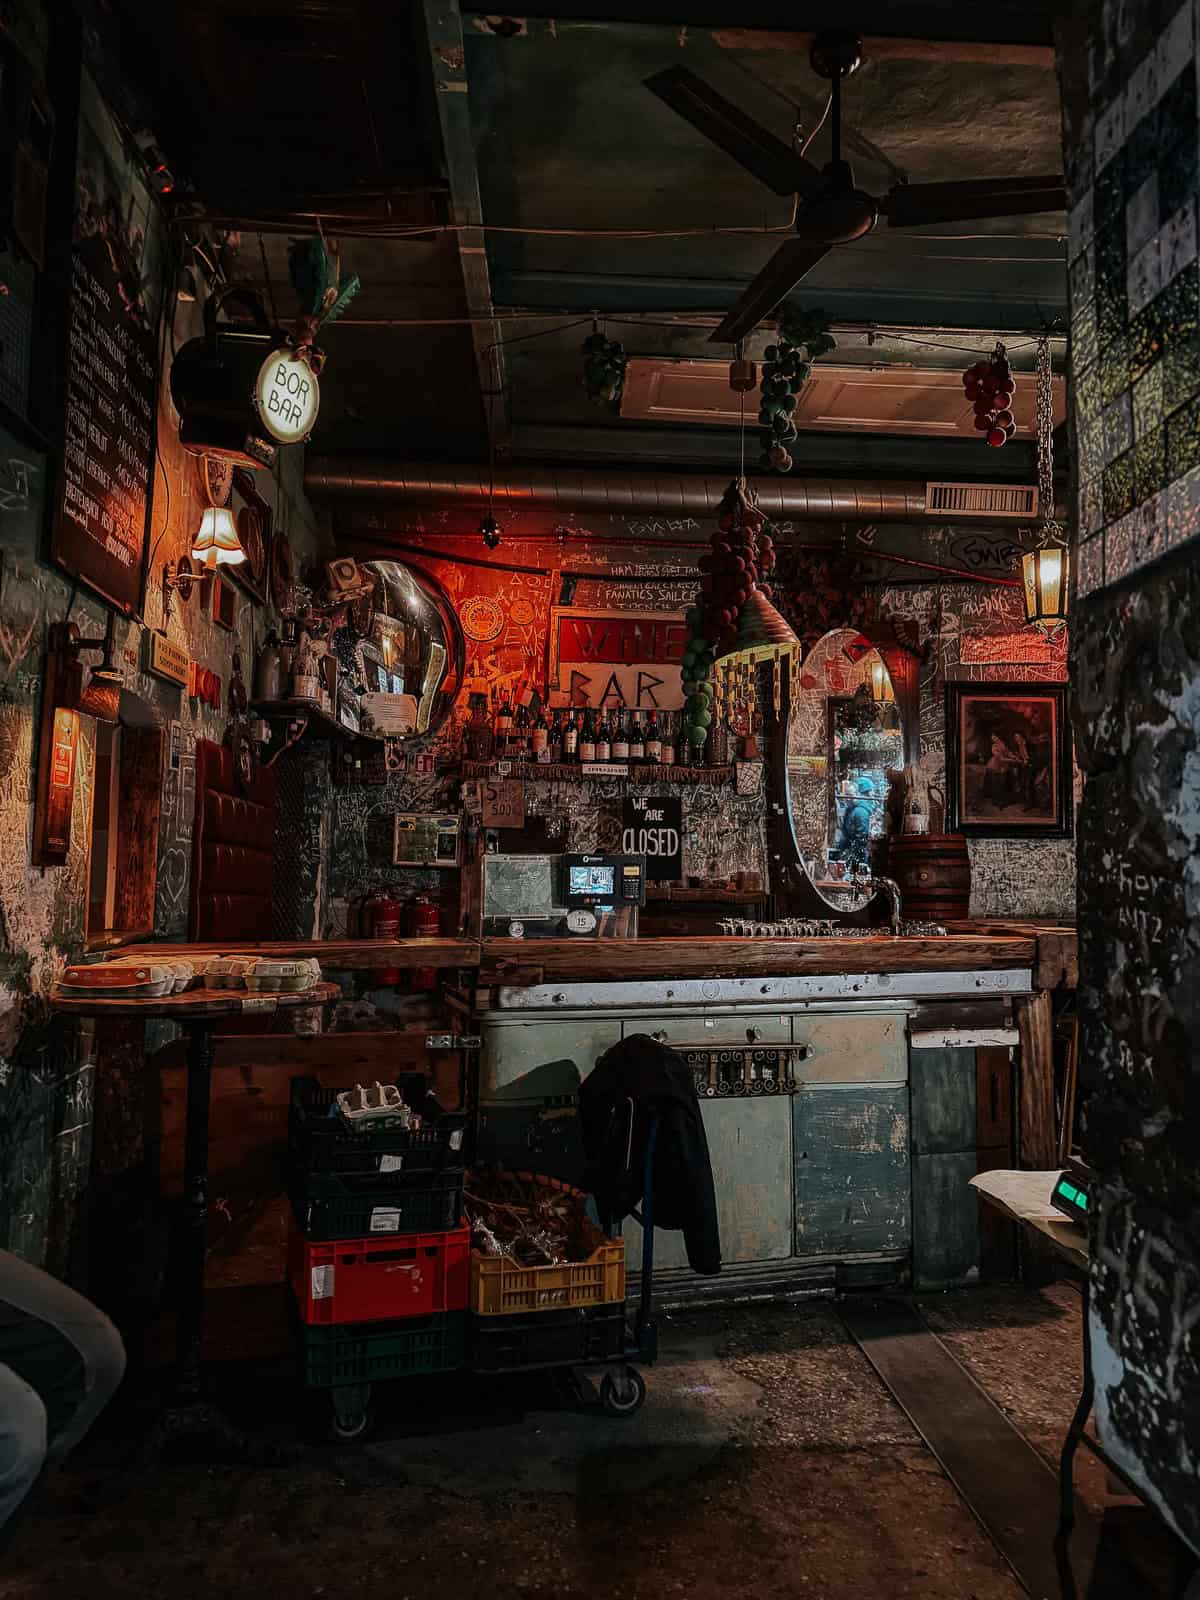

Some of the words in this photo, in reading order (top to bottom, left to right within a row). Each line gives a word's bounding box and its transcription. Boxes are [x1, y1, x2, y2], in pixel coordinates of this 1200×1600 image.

[276, 363, 309, 406] BOR
[268, 390, 302, 428] BAR
[573, 623, 687, 659] WINE
[570, 670, 664, 708] BAR
[632, 798, 649, 810] WE
[644, 809, 665, 821] ARE
[623, 827, 680, 856] CLOSED
